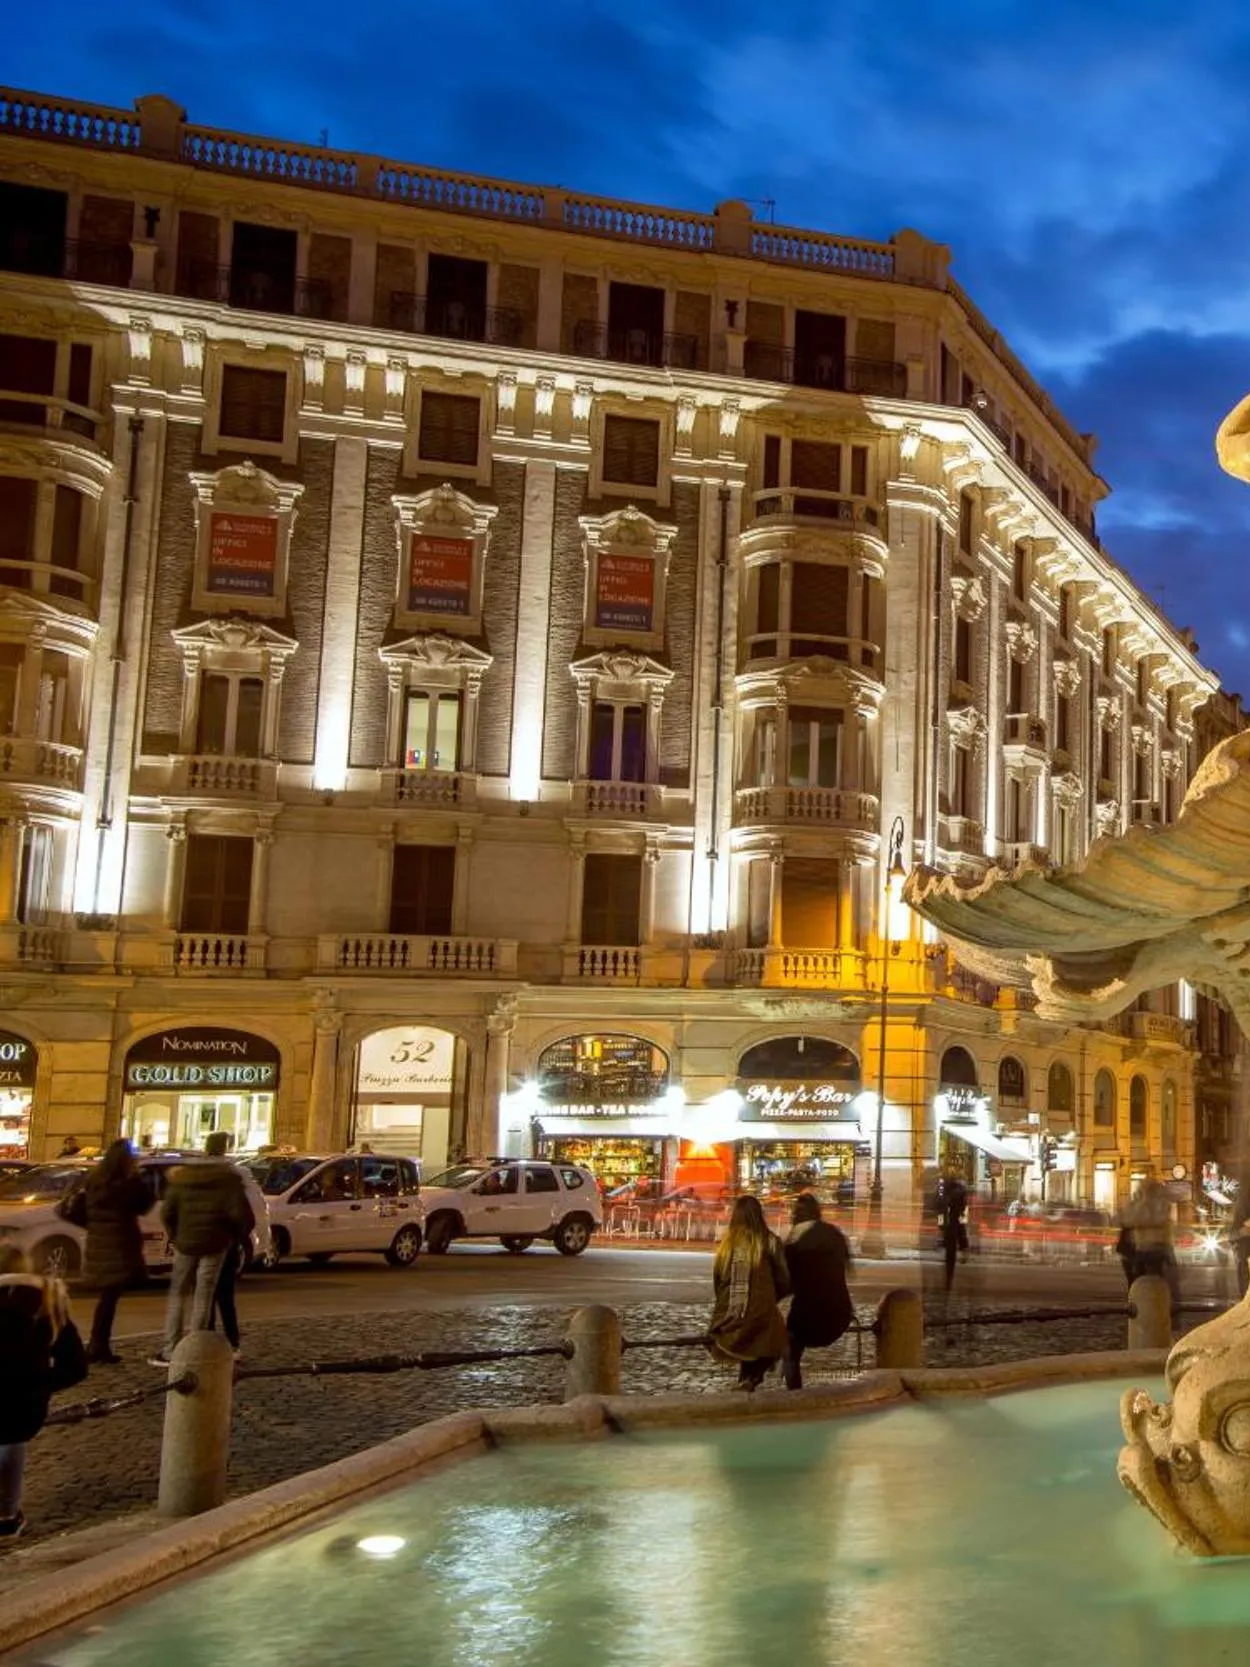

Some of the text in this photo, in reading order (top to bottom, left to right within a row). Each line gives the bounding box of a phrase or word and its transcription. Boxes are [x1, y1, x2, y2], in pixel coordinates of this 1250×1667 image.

[0, 1043, 27, 1060] OP
[162, 1036, 247, 1055] NOMINATION
[390, 1040, 435, 1063] 52
[131, 1065, 272, 1083] GOLD SHOP
[812, 1084, 855, 1103] Bar
[570, 1104, 594, 1115] BAR
[602, 1104, 626, 1115] TEA
